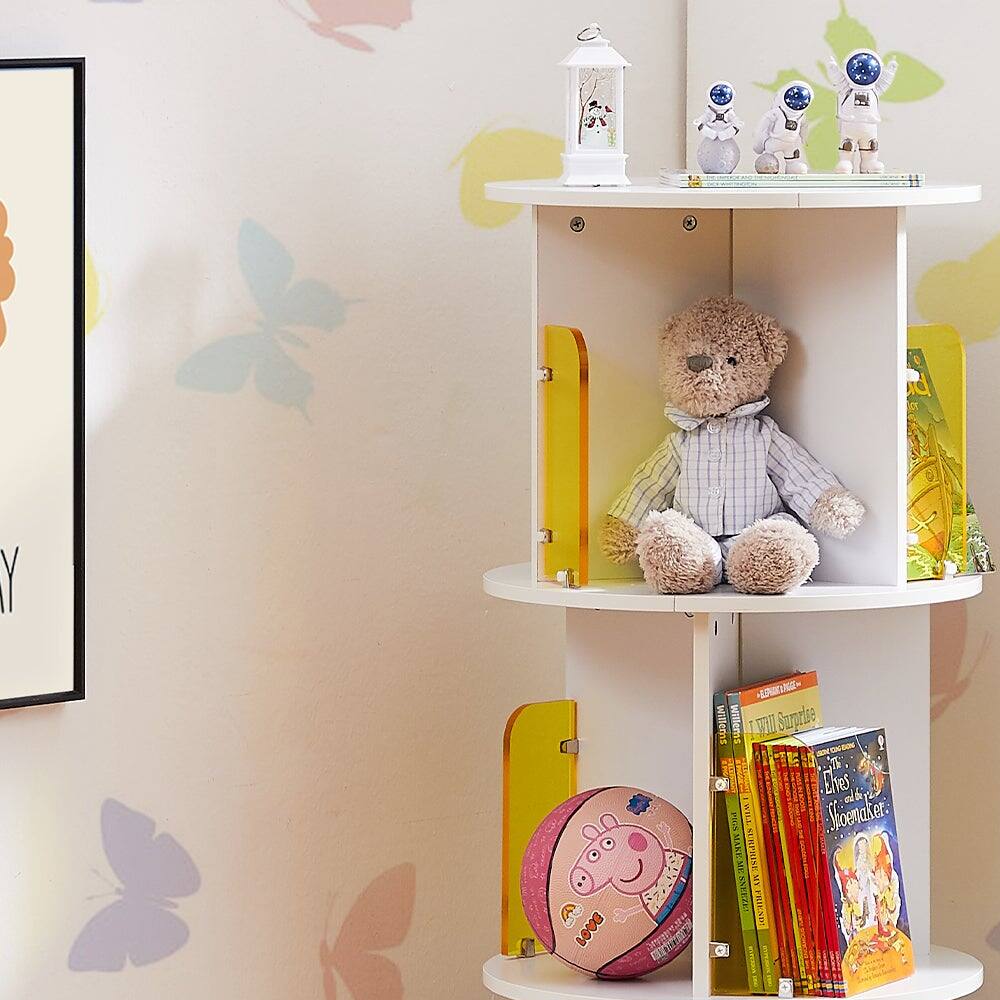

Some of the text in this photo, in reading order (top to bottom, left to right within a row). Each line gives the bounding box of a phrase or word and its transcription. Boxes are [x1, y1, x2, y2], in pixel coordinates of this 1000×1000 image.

[717, 704, 728, 745] Willems
[730, 704, 742, 744] Willems
[777, 704, 817, 732] Surprise
[830, 756, 842, 770] The
[823, 765, 850, 795] Elves
[844, 786, 863, 804] and the
[730, 812, 739, 831] PIGS
[828, 793, 885, 832] Shoemaker
[733, 834, 742, 858] MAKE
[747, 828, 758, 872] SURPRISE
[753, 875, 760, 886] MY
[755, 890, 766, 927] FRIEND!
[576, 911, 604, 946] LOVE
